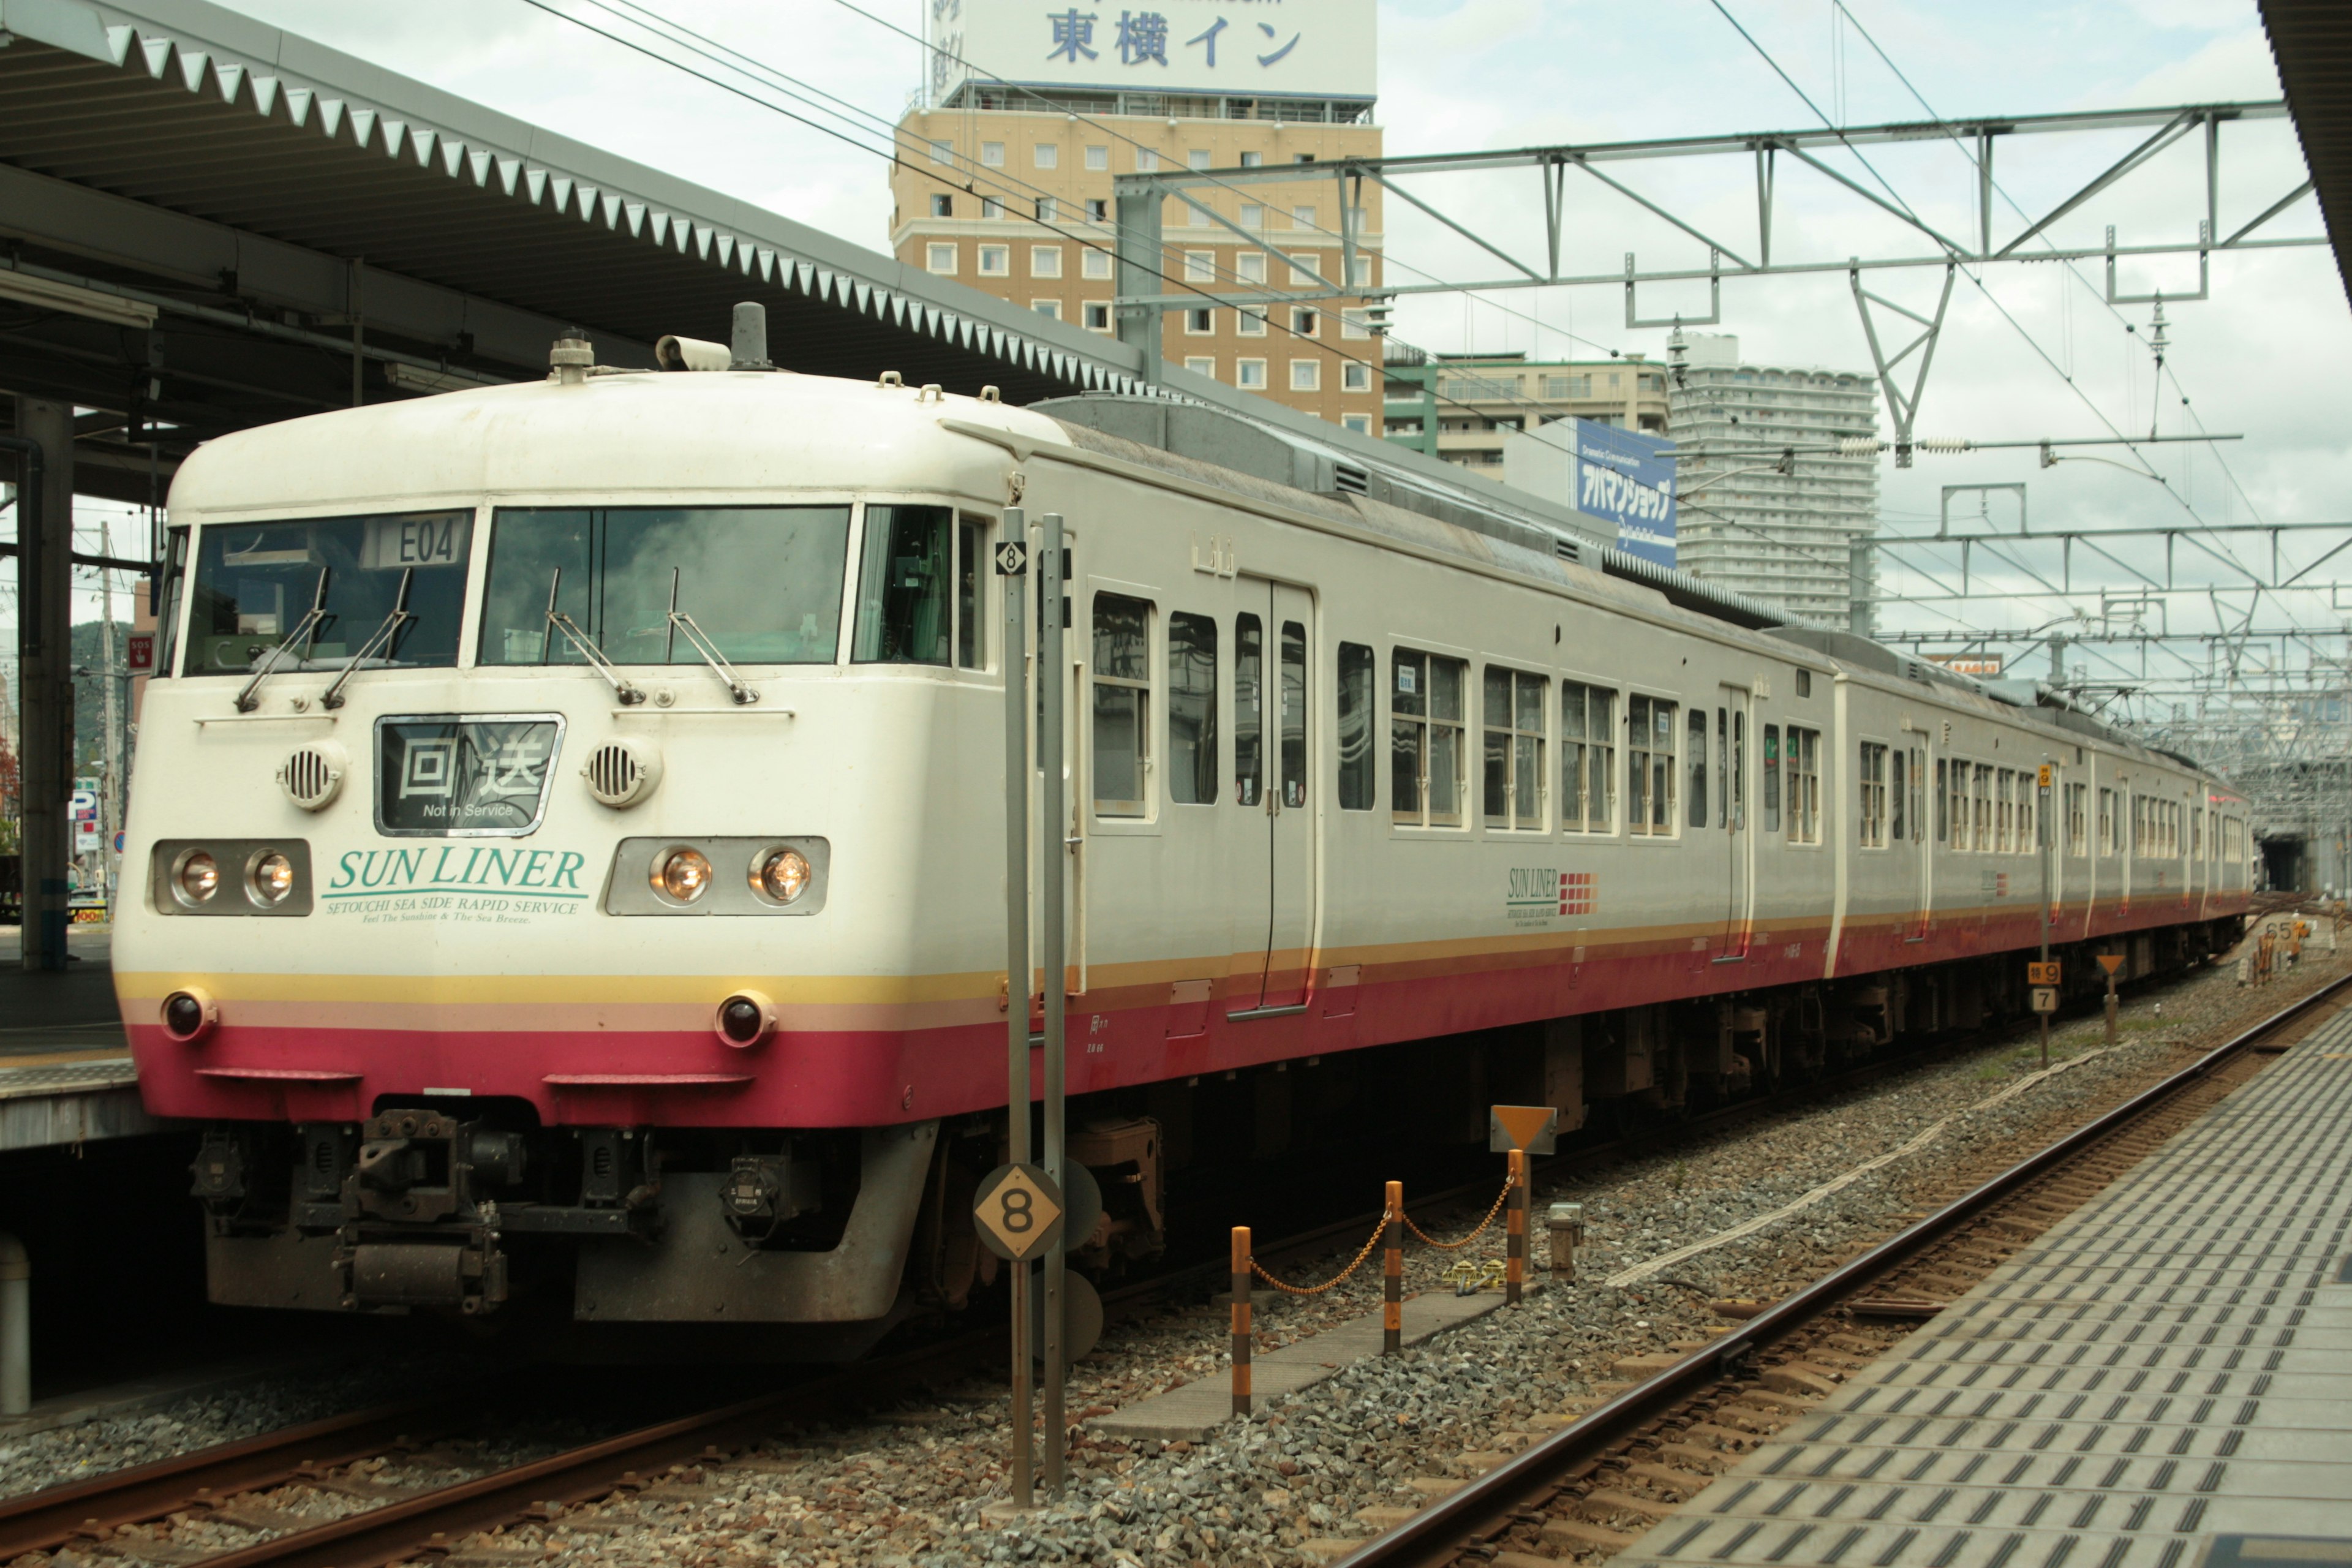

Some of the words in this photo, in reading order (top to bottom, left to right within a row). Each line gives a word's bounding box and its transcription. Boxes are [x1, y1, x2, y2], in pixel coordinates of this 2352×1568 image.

[1047, 7, 1300, 67] 東横イン
[1582, 463, 1671, 522] アパマンショップ
[400, 518, 453, 562] E04
[1006, 548, 1016, 568] 8
[131, 641, 150, 649] SOS
[399, 736, 543, 799] 回送
[2041, 774, 2049, 783] 9
[69, 792, 95, 820] P
[423, 804, 447, 816] Not
[450, 804, 461, 816] in
[465, 804, 513, 816] Service
[330, 848, 428, 888] SUN
[429, 846, 585, 889] LINER
[1508, 868, 1529, 899] SUN
[1530, 869, 1558, 898] LINER
[326, 900, 391, 914] SETOUCHI
[393, 899, 416, 911] SEA
[421, 897, 454, 909] SIDE
[458, 898, 509, 911] RAPID
[513, 901, 579, 914] SERVICE
[363, 914, 382, 924] Feel
[400, 913, 437, 922] Sunshine
[454, 912, 472, 921] The
[475, 913, 492, 922] Sea
[496, 914, 531, 924] Breeze.
[2266, 922, 2291, 940] 65
[2046, 965, 2058, 982] 9
[2038, 992, 2049, 1008] 7
[1001, 1188, 1033, 1233] 8
